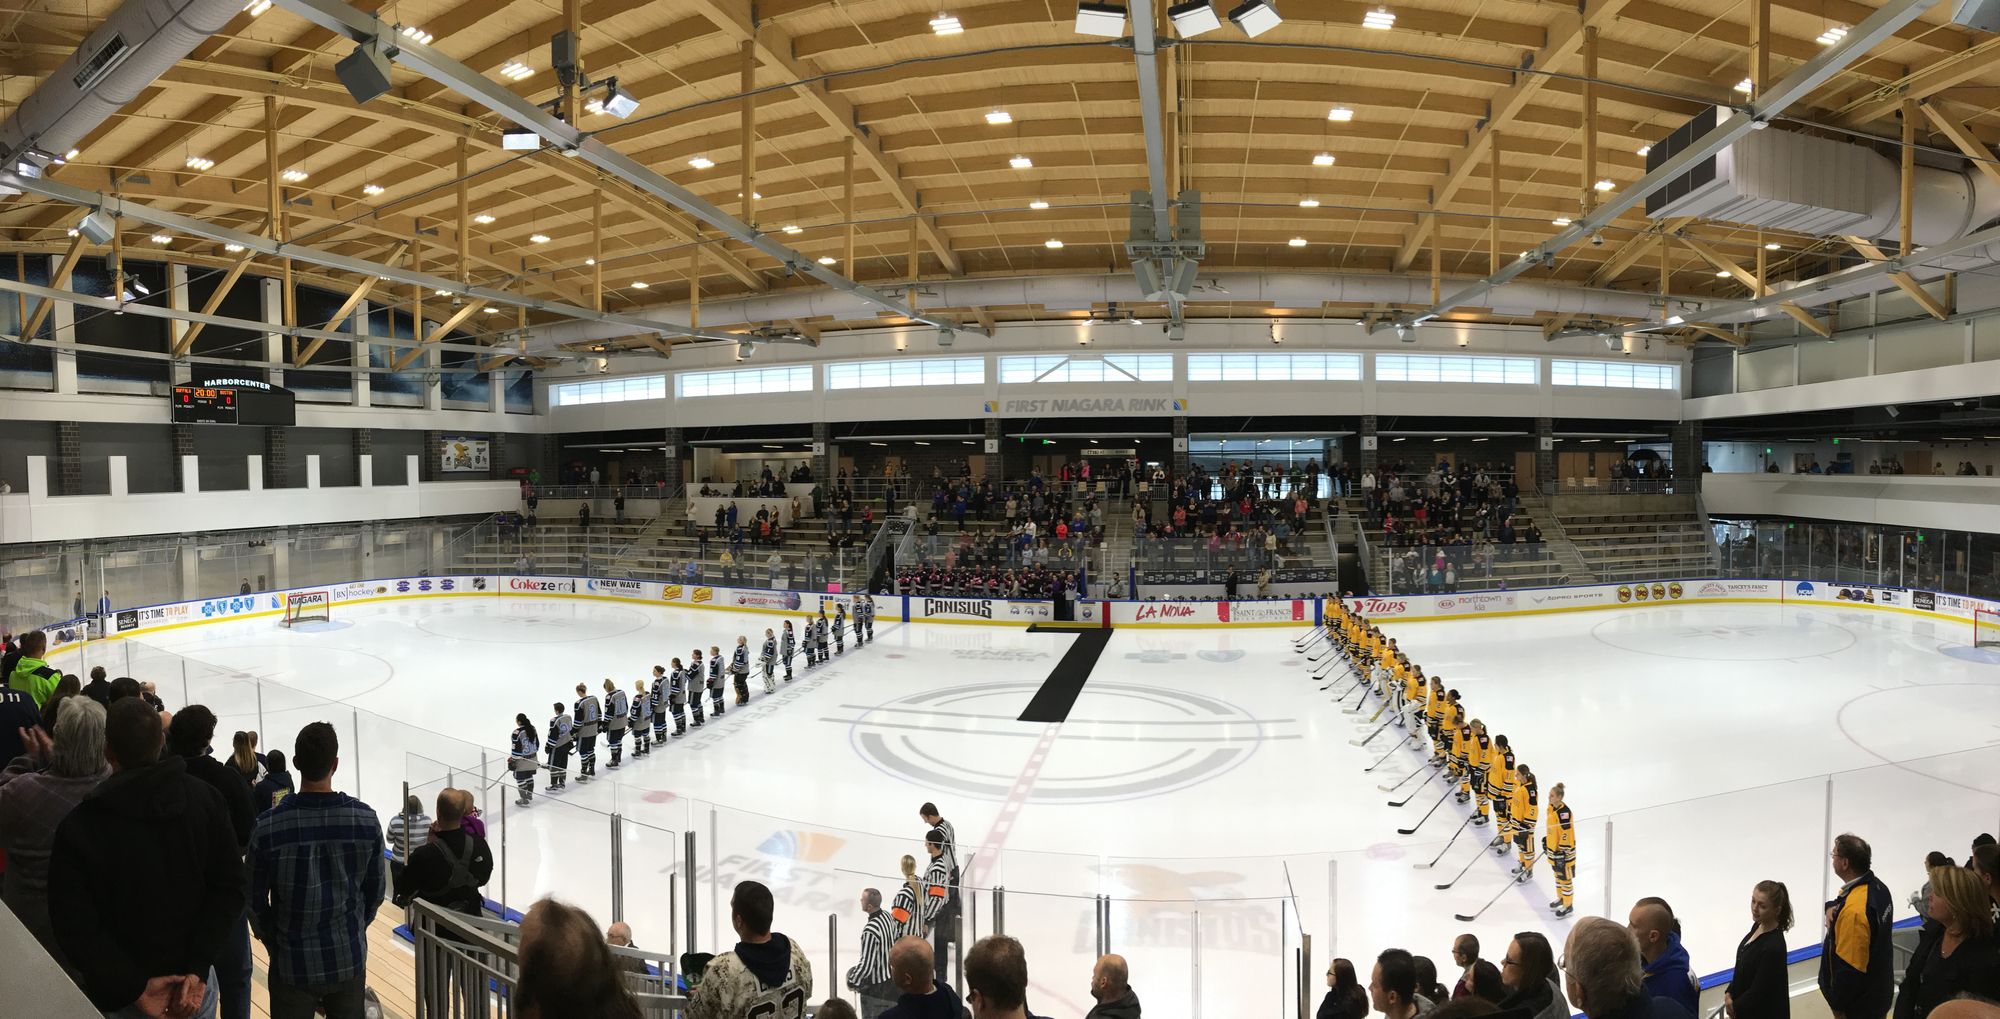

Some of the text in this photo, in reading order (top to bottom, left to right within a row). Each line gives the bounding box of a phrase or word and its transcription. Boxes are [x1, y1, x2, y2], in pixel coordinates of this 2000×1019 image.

[204, 378, 271, 390] HARBORCENTER
[183, 394, 189, 403] 0
[226, 396, 232, 405] 0
[1005, 398, 1167, 413] FIRST NIAGARA RINK
[600, 579, 641, 589] NEW WAVE
[348, 587, 374, 597] hockey
[289, 595, 323, 605] NIAGARA
[1458, 595, 1502, 604] northtown
[1914, 597, 1934, 606] SENECA
[1936, 596, 1984, 610] IT'S TIME TO PLAY
[924, 598, 992, 619] CANISIUS
[1136, 603, 1195, 621] LA NOVA
[1474, 603, 1486, 611] kia
[138, 605, 189, 620] IT'S TIME TO PLAY
[118, 617, 137, 626] SENECA
[658, 861, 856, 917] NIAARA
